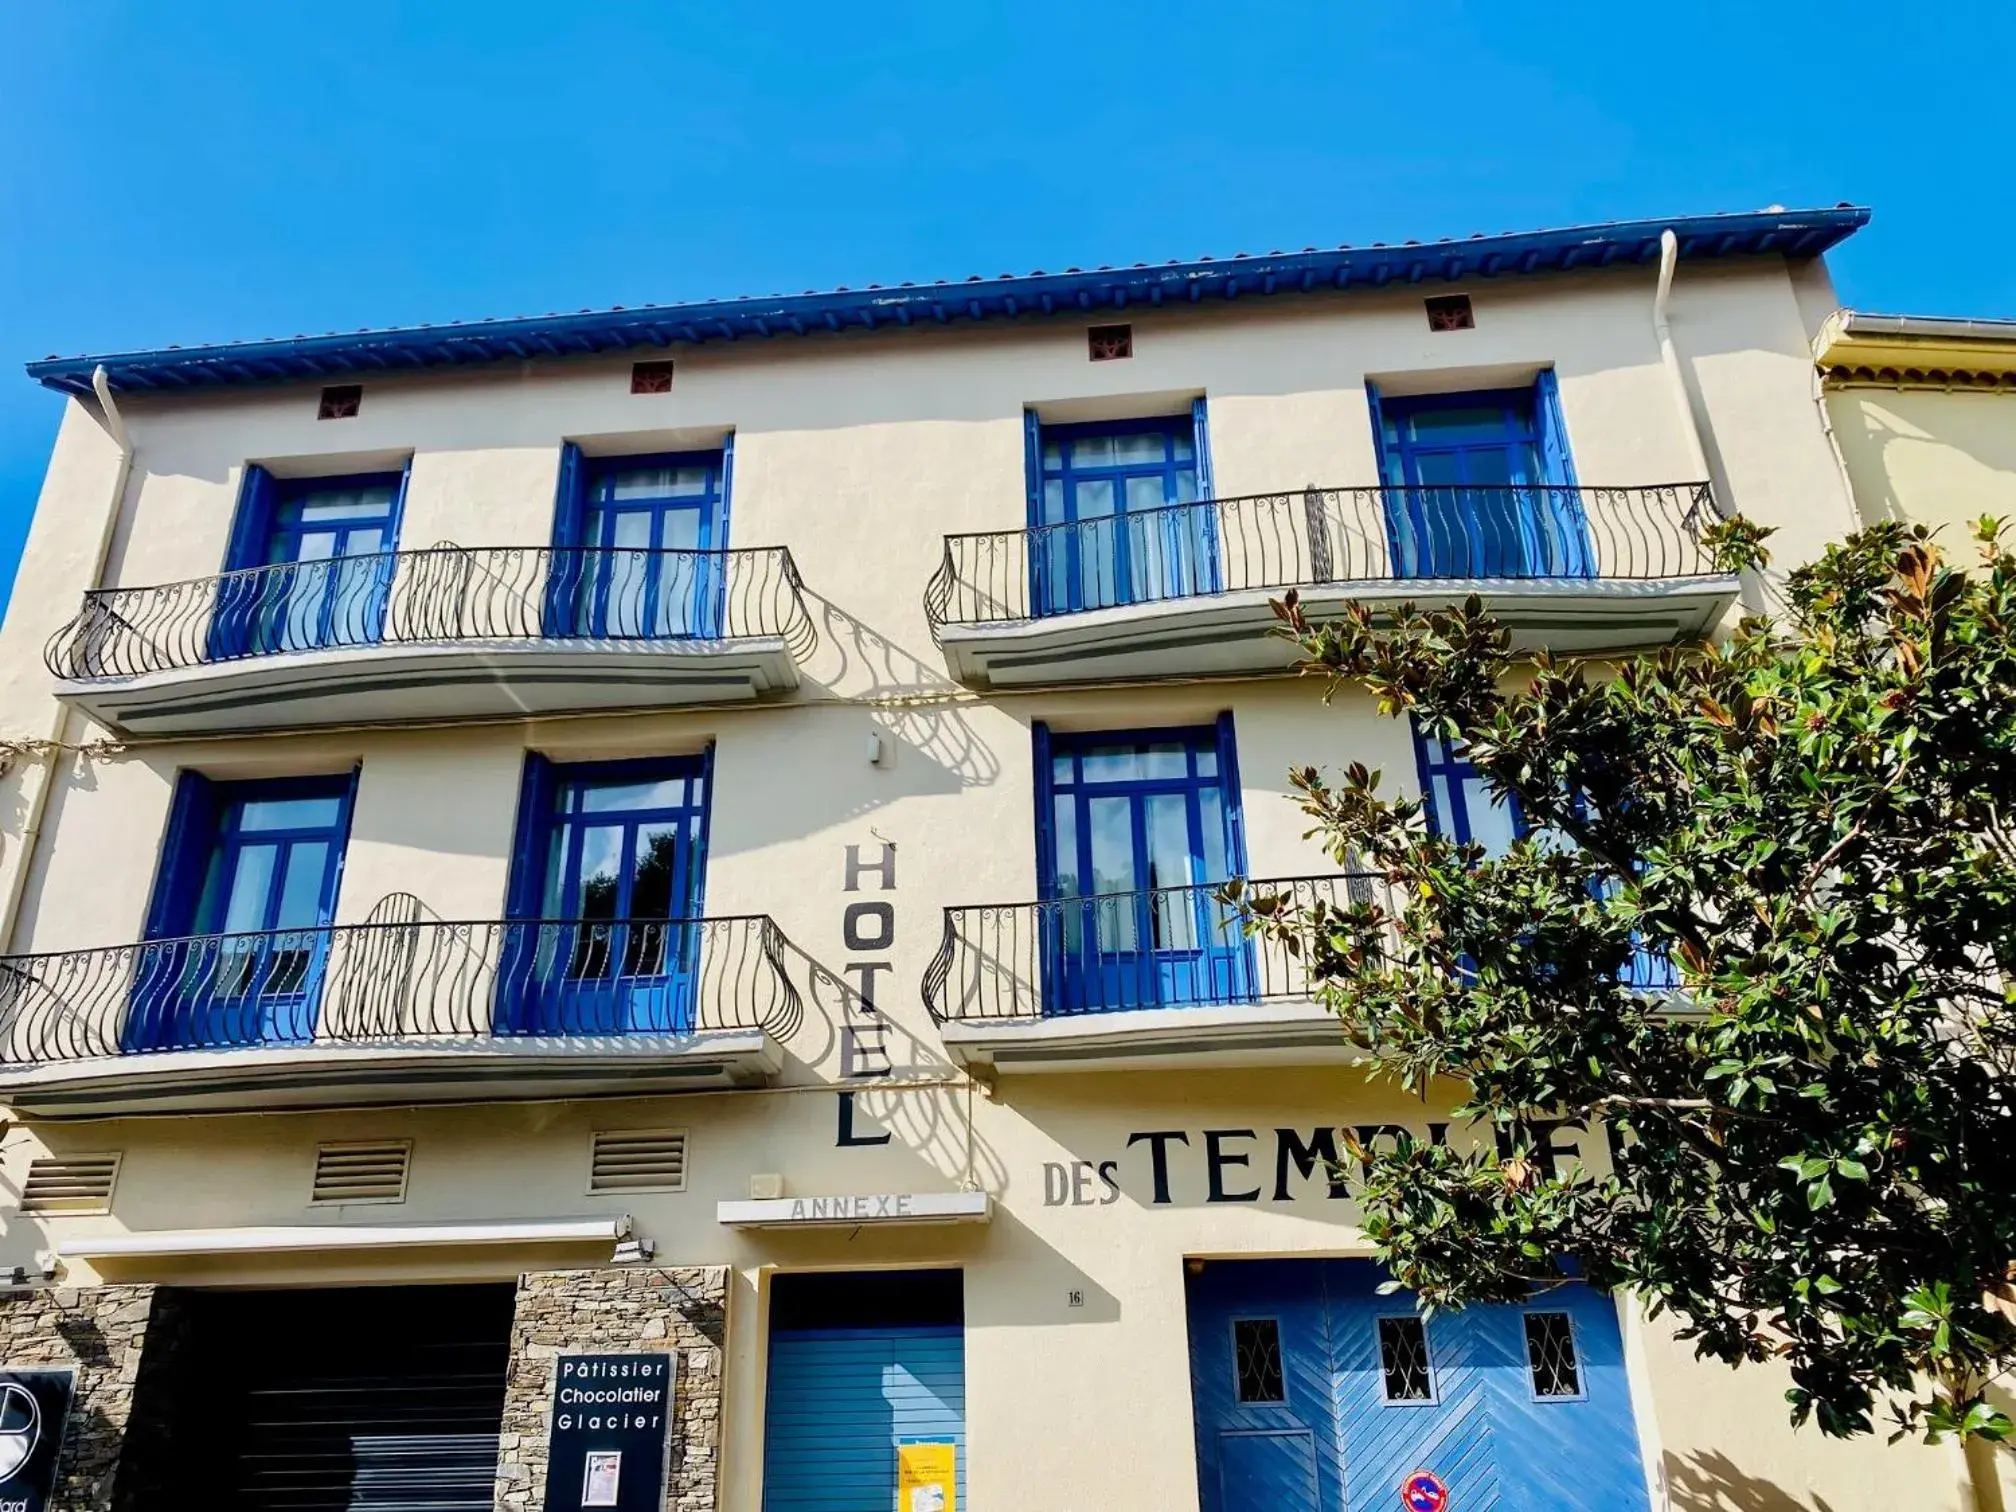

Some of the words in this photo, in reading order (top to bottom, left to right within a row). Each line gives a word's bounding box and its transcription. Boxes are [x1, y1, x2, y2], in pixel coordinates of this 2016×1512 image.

[835, 844, 896, 1147] HOTEL
[1043, 1161, 1120, 1206] DES
[791, 1194, 912, 1220] ANNEXE
[1069, 1291, 1081, 1304] 16
[563, 1361, 663, 1378] Pâtissier
[560, 1387, 661, 1403] Chocolatier
[558, 1413, 659, 1430] Glacier
